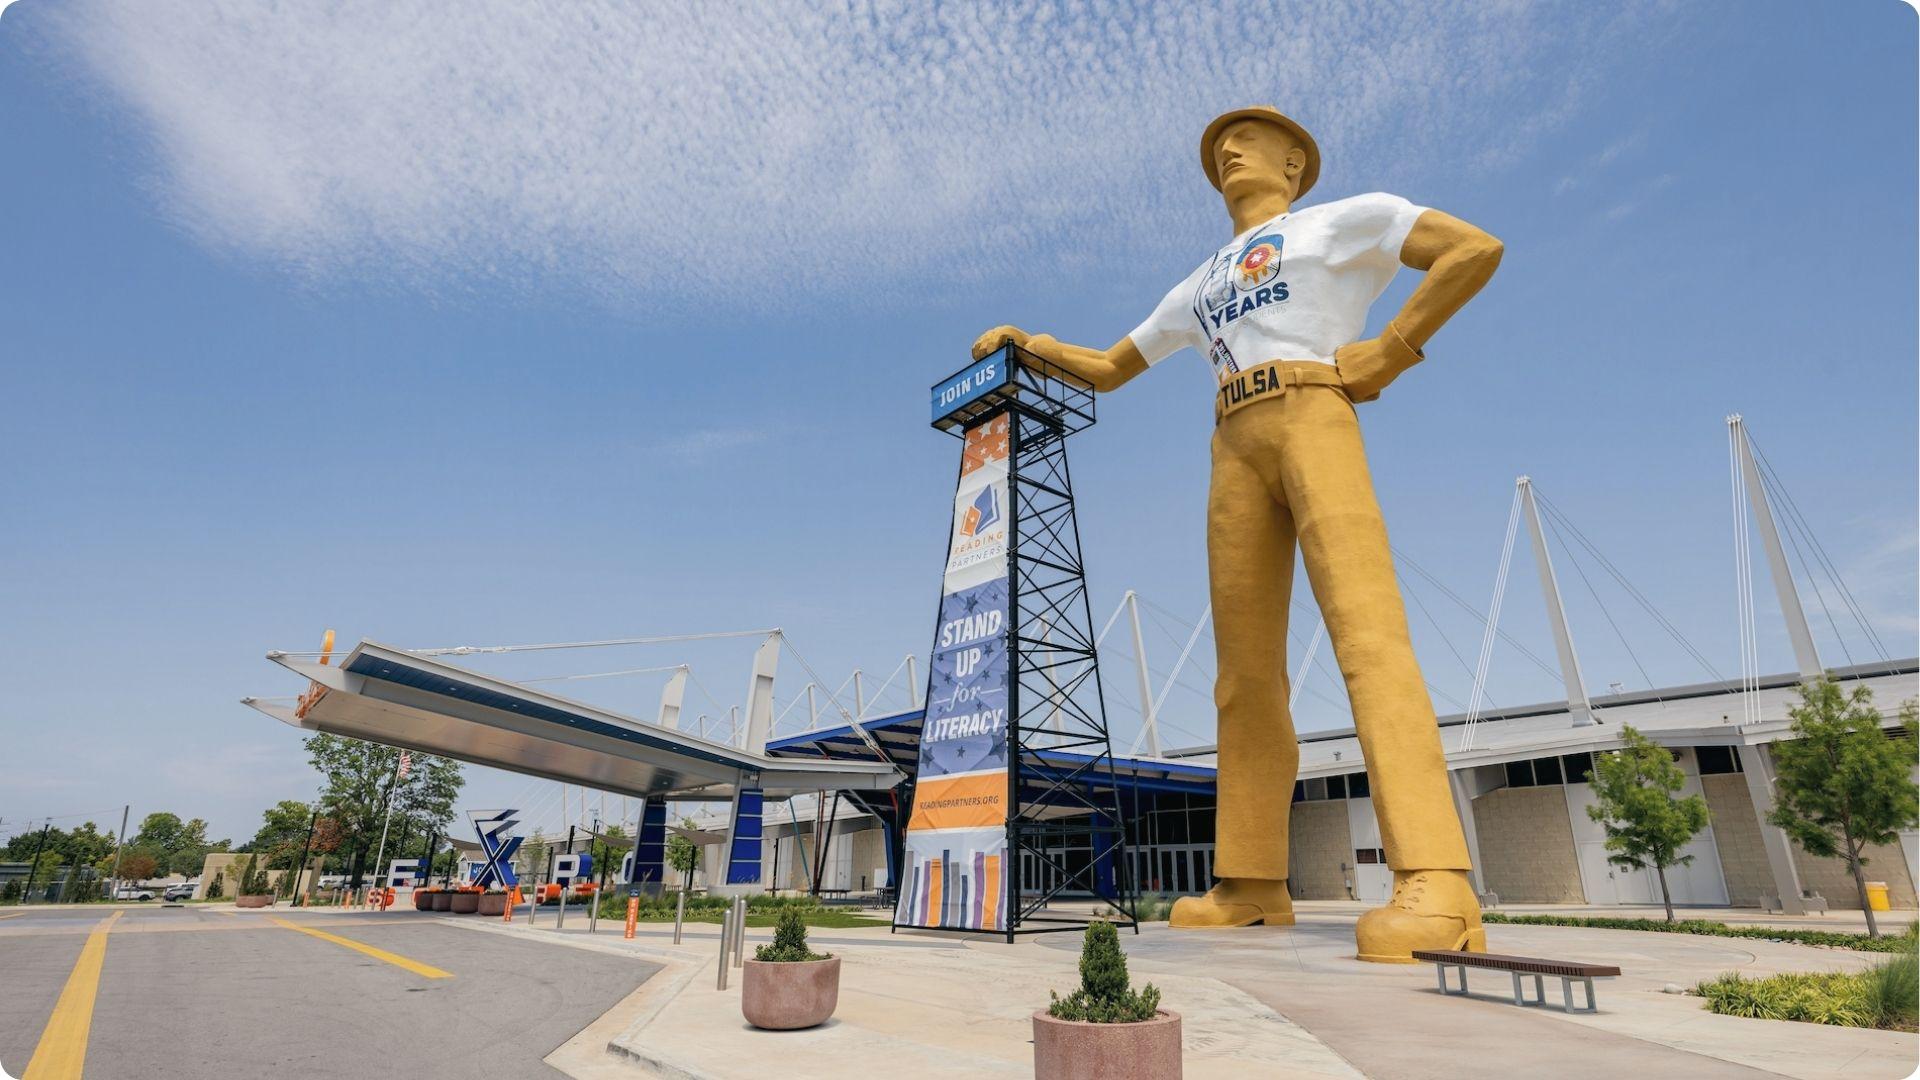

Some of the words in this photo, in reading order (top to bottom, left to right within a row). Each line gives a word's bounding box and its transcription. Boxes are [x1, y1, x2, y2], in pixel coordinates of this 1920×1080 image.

[1209, 281, 1290, 329] YEARS
[940, 381, 971, 407] JOIN
[975, 364, 996, 385] US
[1221, 366, 1280, 408] TULSA
[951, 545, 1001, 568] PARTNERS
[941, 609, 1002, 648] STAND
[956, 648, 981, 677] UP
[946, 682, 981, 712] for
[925, 709, 1004, 743] LITERACY
